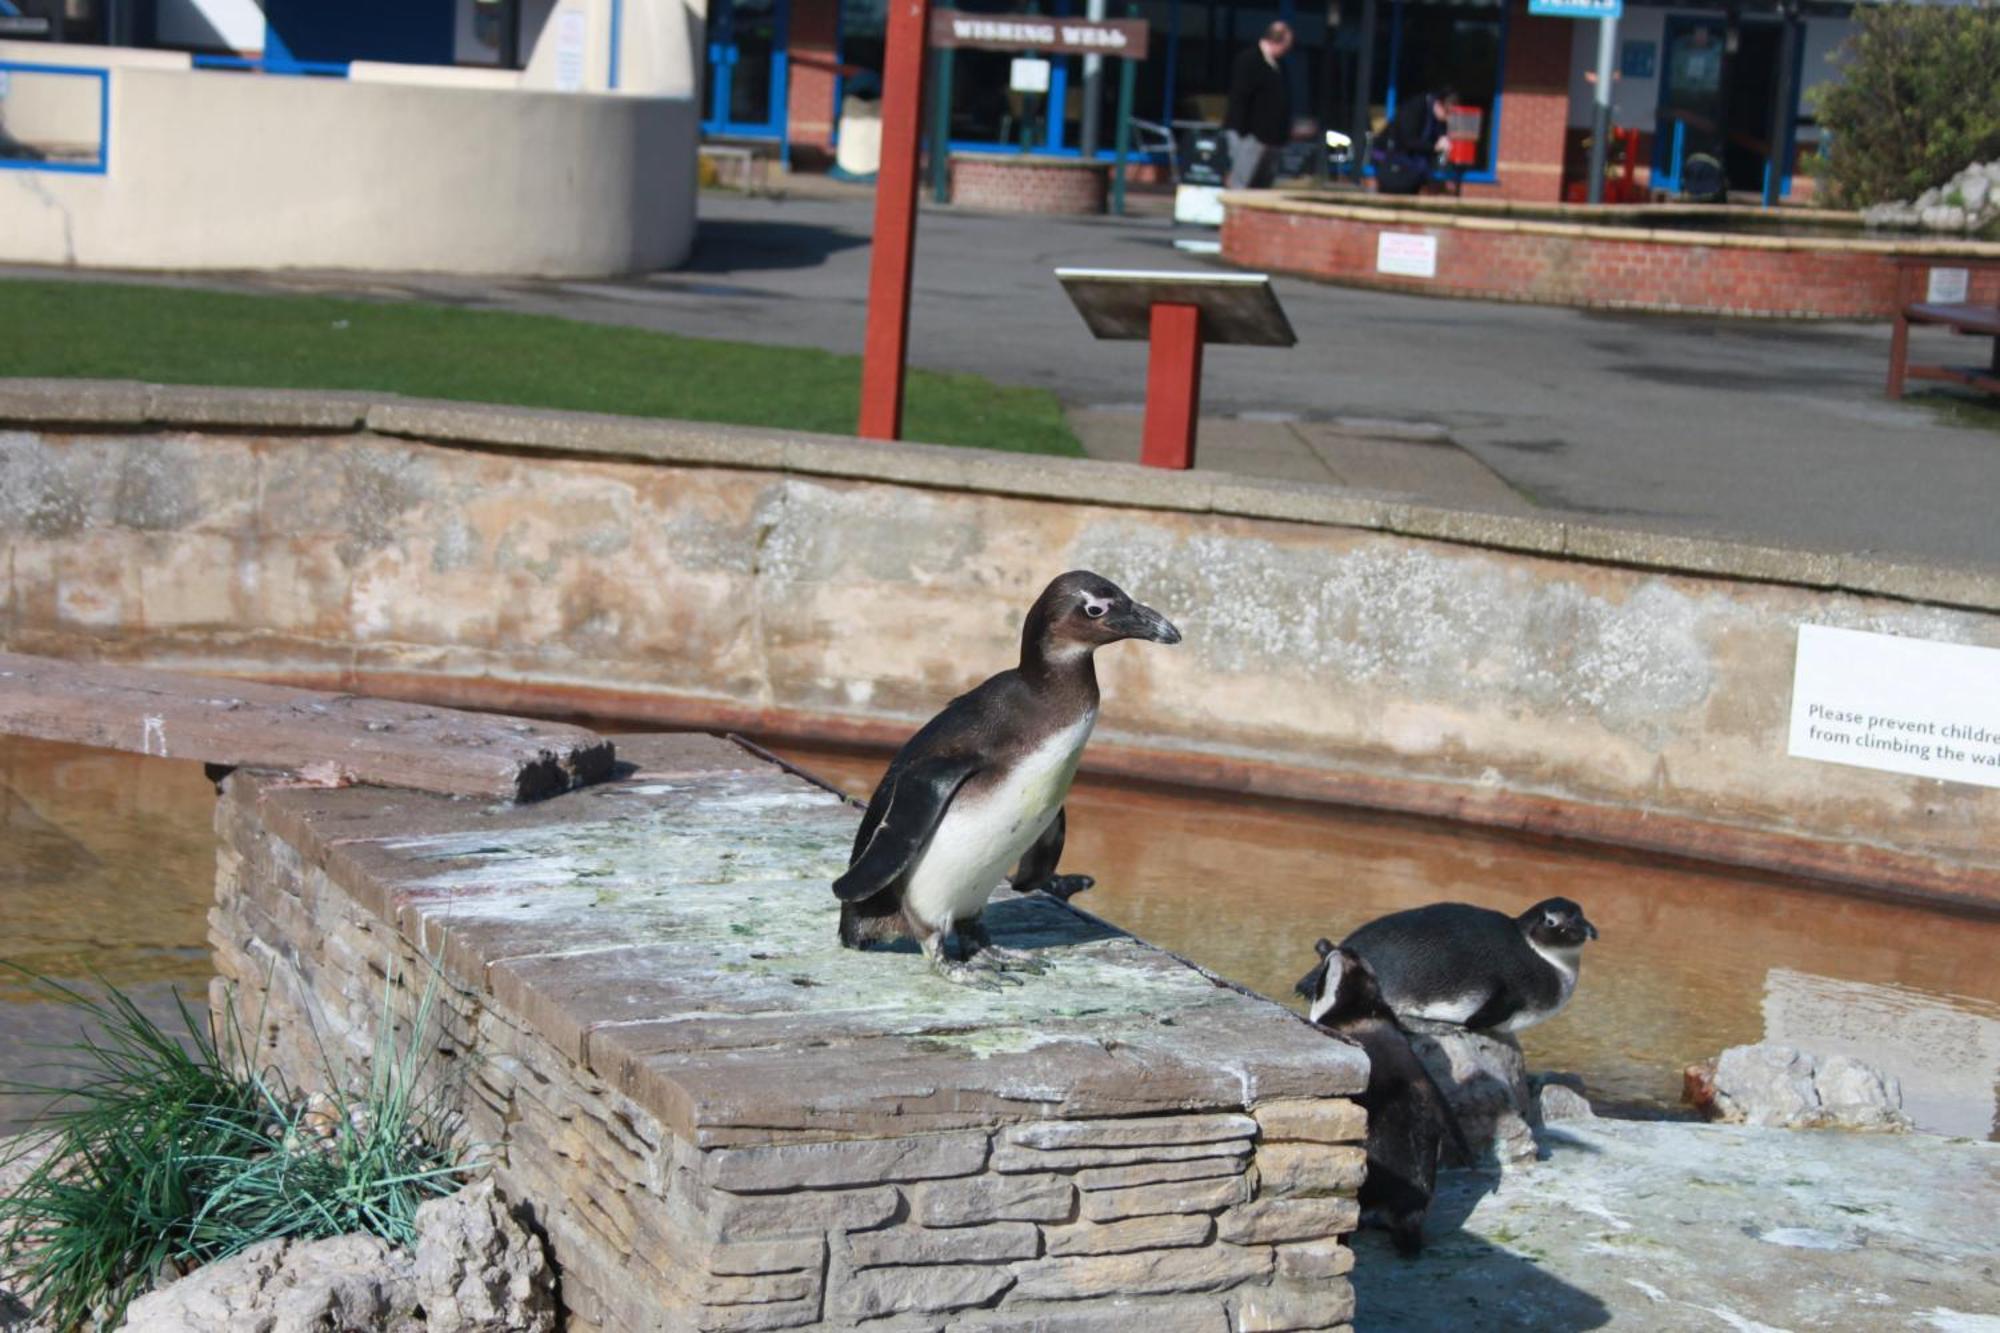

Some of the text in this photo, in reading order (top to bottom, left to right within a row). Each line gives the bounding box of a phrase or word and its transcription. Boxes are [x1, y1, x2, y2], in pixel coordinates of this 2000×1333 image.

[1808, 703, 1863, 725] Please
[1868, 715, 1936, 736] prevent
[1809, 725, 1850, 745] from
[1856, 733, 1931, 761] climbing
[1937, 745, 1965, 762] the
